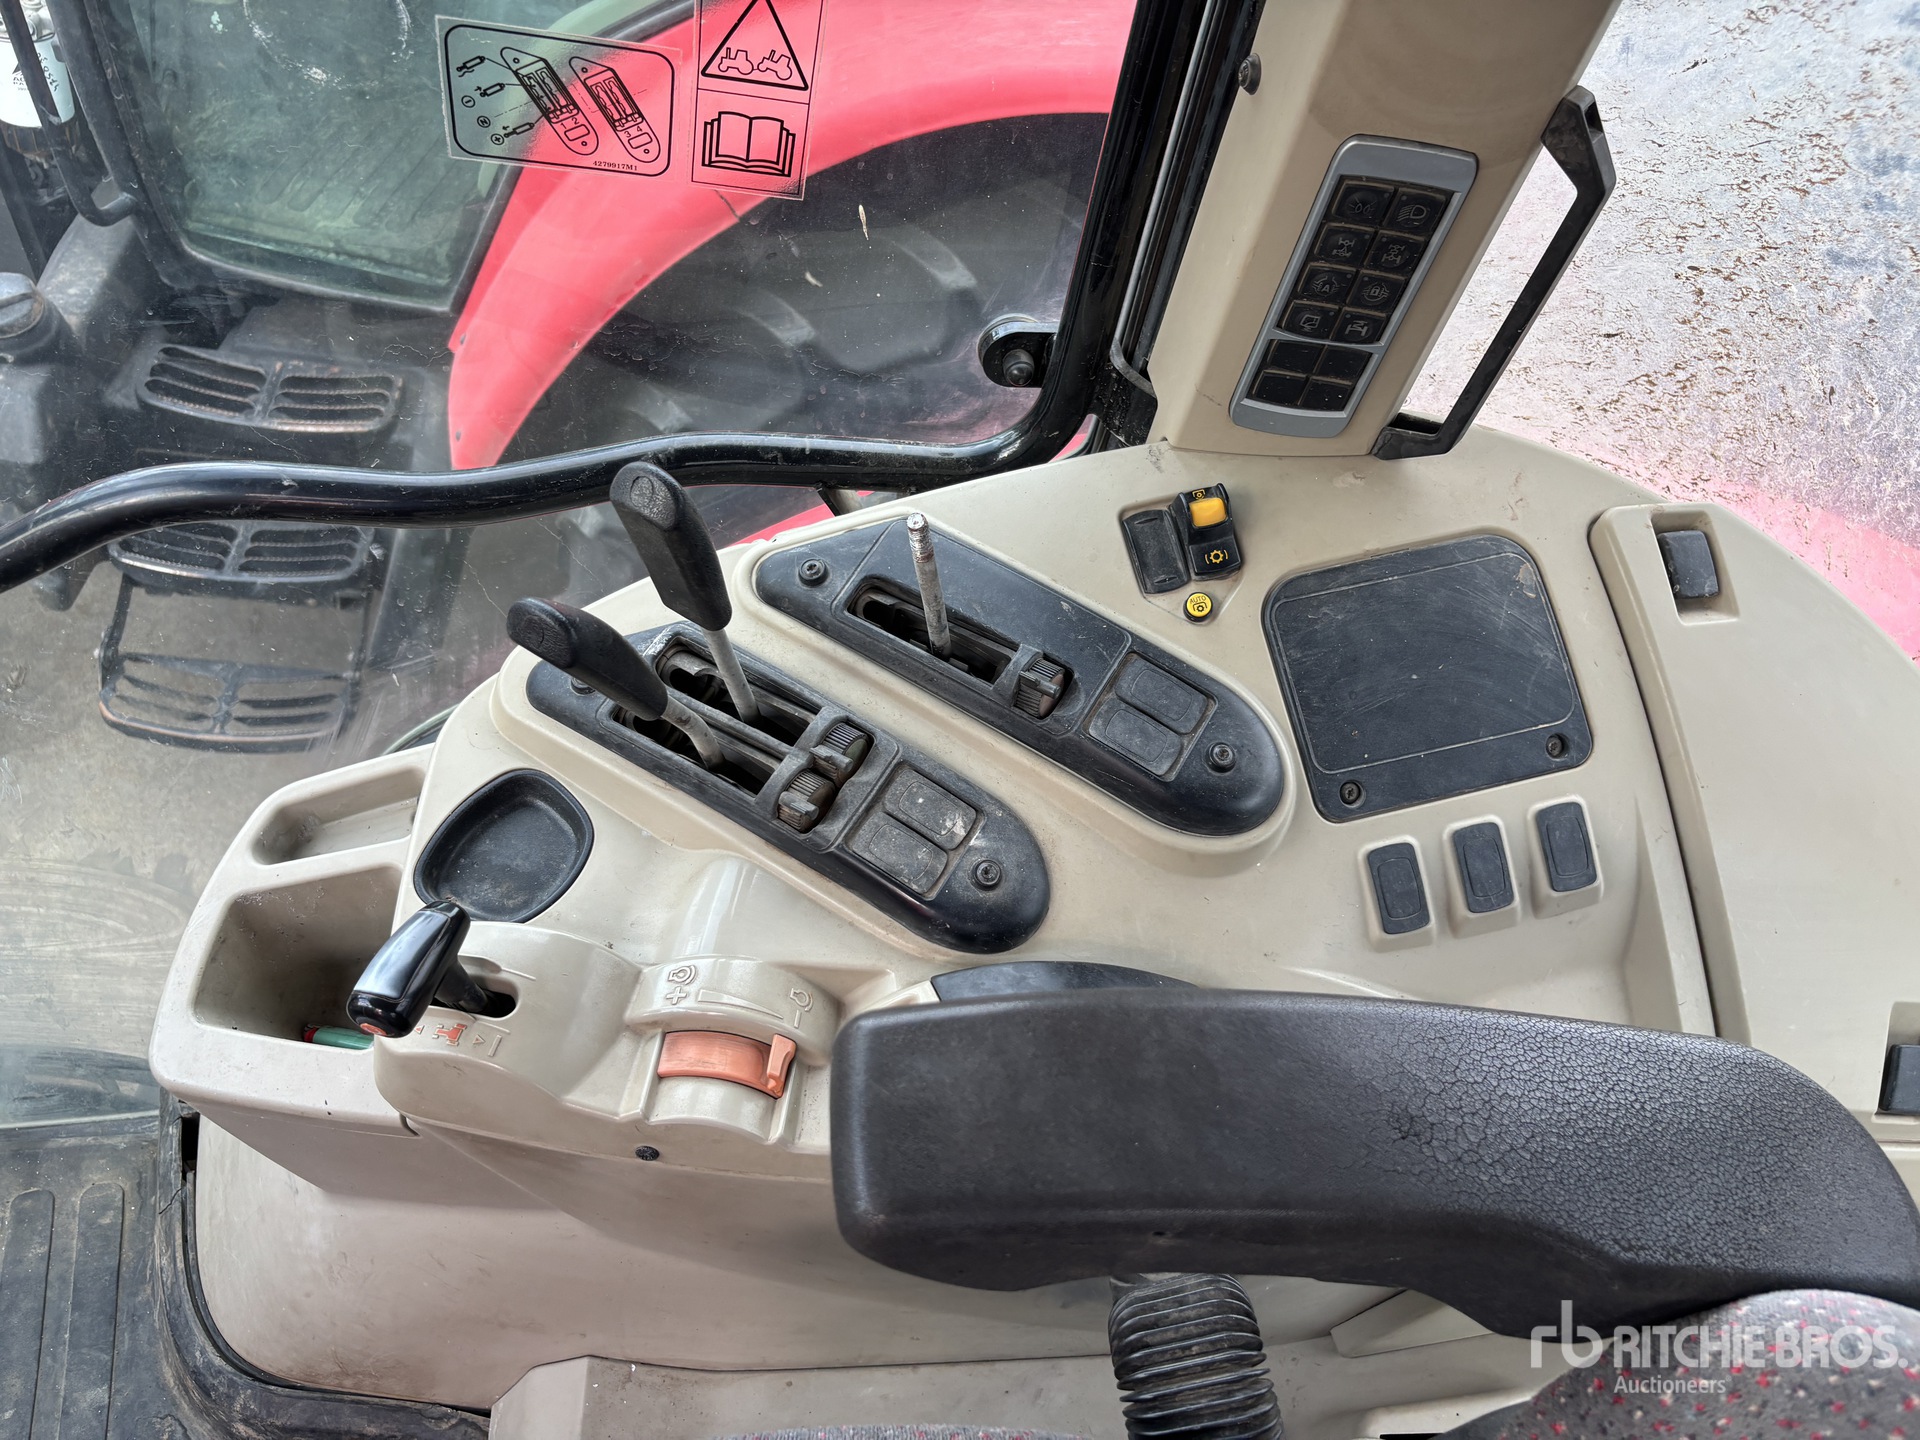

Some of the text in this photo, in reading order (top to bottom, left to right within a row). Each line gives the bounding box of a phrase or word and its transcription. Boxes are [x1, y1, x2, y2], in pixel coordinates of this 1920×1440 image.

[560, 116, 580, 130] 1 2
[623, 125, 643, 139] 3 4
[593, 160, 638, 171] 4279917M1
[1190, 595, 1206, 604] AUTO
